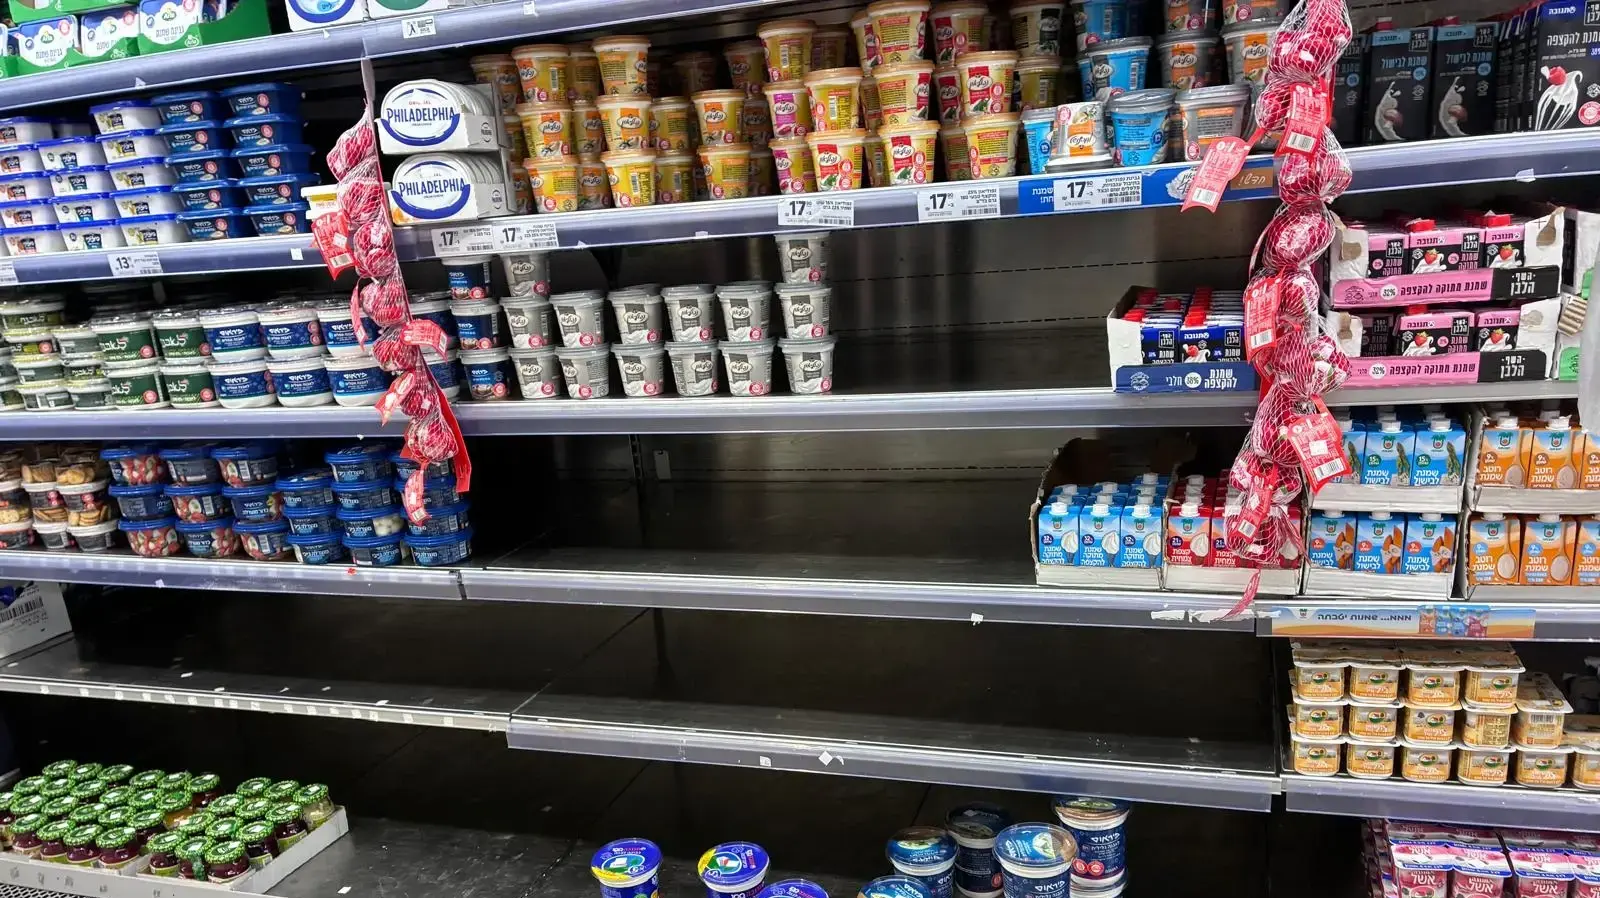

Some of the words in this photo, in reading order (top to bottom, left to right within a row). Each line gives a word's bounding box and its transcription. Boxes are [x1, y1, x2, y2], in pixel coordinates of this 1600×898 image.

[1547, 31, 1580, 46] להקצפה
[387, 107, 455, 124] PHILADELPHIA
[1239, 174, 1265, 186] חדש!
[398, 177, 466, 197] PHILADELPHIA
[1067, 181, 1086, 198] 17
[930, 193, 947, 209] 17
[789, 200, 805, 216] 17
[441, 231, 453, 246] 17
[502, 227, 516, 242] 17
[1490, 233, 1514, 241] תנובה
[1416, 237, 1438, 245] תנובה
[116, 256, 129, 269] 13
[1513, 272, 1533, 282] השף
[1399, 284, 1433, 297] להקצפה
[1431, 283, 1462, 294] מתוקה
[1464, 281, 1488, 292] שמנת
[1510, 282, 1535, 296] הלבן
[1406, 320, 1429, 328] תנובה
[1483, 316, 1505, 324] תנובה
[1506, 355, 1524, 364] השף
[1389, 366, 1422, 378] להקצפה
[1422, 365, 1450, 375] מתוקה
[1452, 363, 1476, 373] שמנת
[1500, 364, 1525, 378] הלבן
[1209, 368, 1233, 379] שמנת
[1165, 375, 1182, 386] חלבי
[1204, 378, 1237, 390] להקצפה
[1367, 468, 1389, 477] שמנת
[1416, 469, 1439, 477] שמנת
[1483, 465, 1501, 473] רוטב
[1365, 476, 1390, 485] לבישול
[1413, 477, 1440, 486] לבישול
[1480, 473, 1503, 481] שמנת
[1531, 475, 1555, 483] שמנת
[1082, 552, 1103, 560] מתוקה
[1123, 553, 1145, 561] מתוקה
[1312, 552, 1333, 560] שמנת
[1358, 555, 1380, 563] שמנת
[1407, 556, 1430, 564] שמנת
[1528, 556, 1547, 564] רוטב
[1356, 562, 1381, 570] לבישול
[1405, 563, 1430, 571] לבישול
[1472, 563, 1496, 571] שמנת
[1317, 613, 1348, 621] יטבתה
[1350, 613, 1378, 621] שמנות
[1411, 872, 1437, 885] אשל
[1468, 879, 1494, 893] אשל
[1533, 880, 1558, 893] אשל
